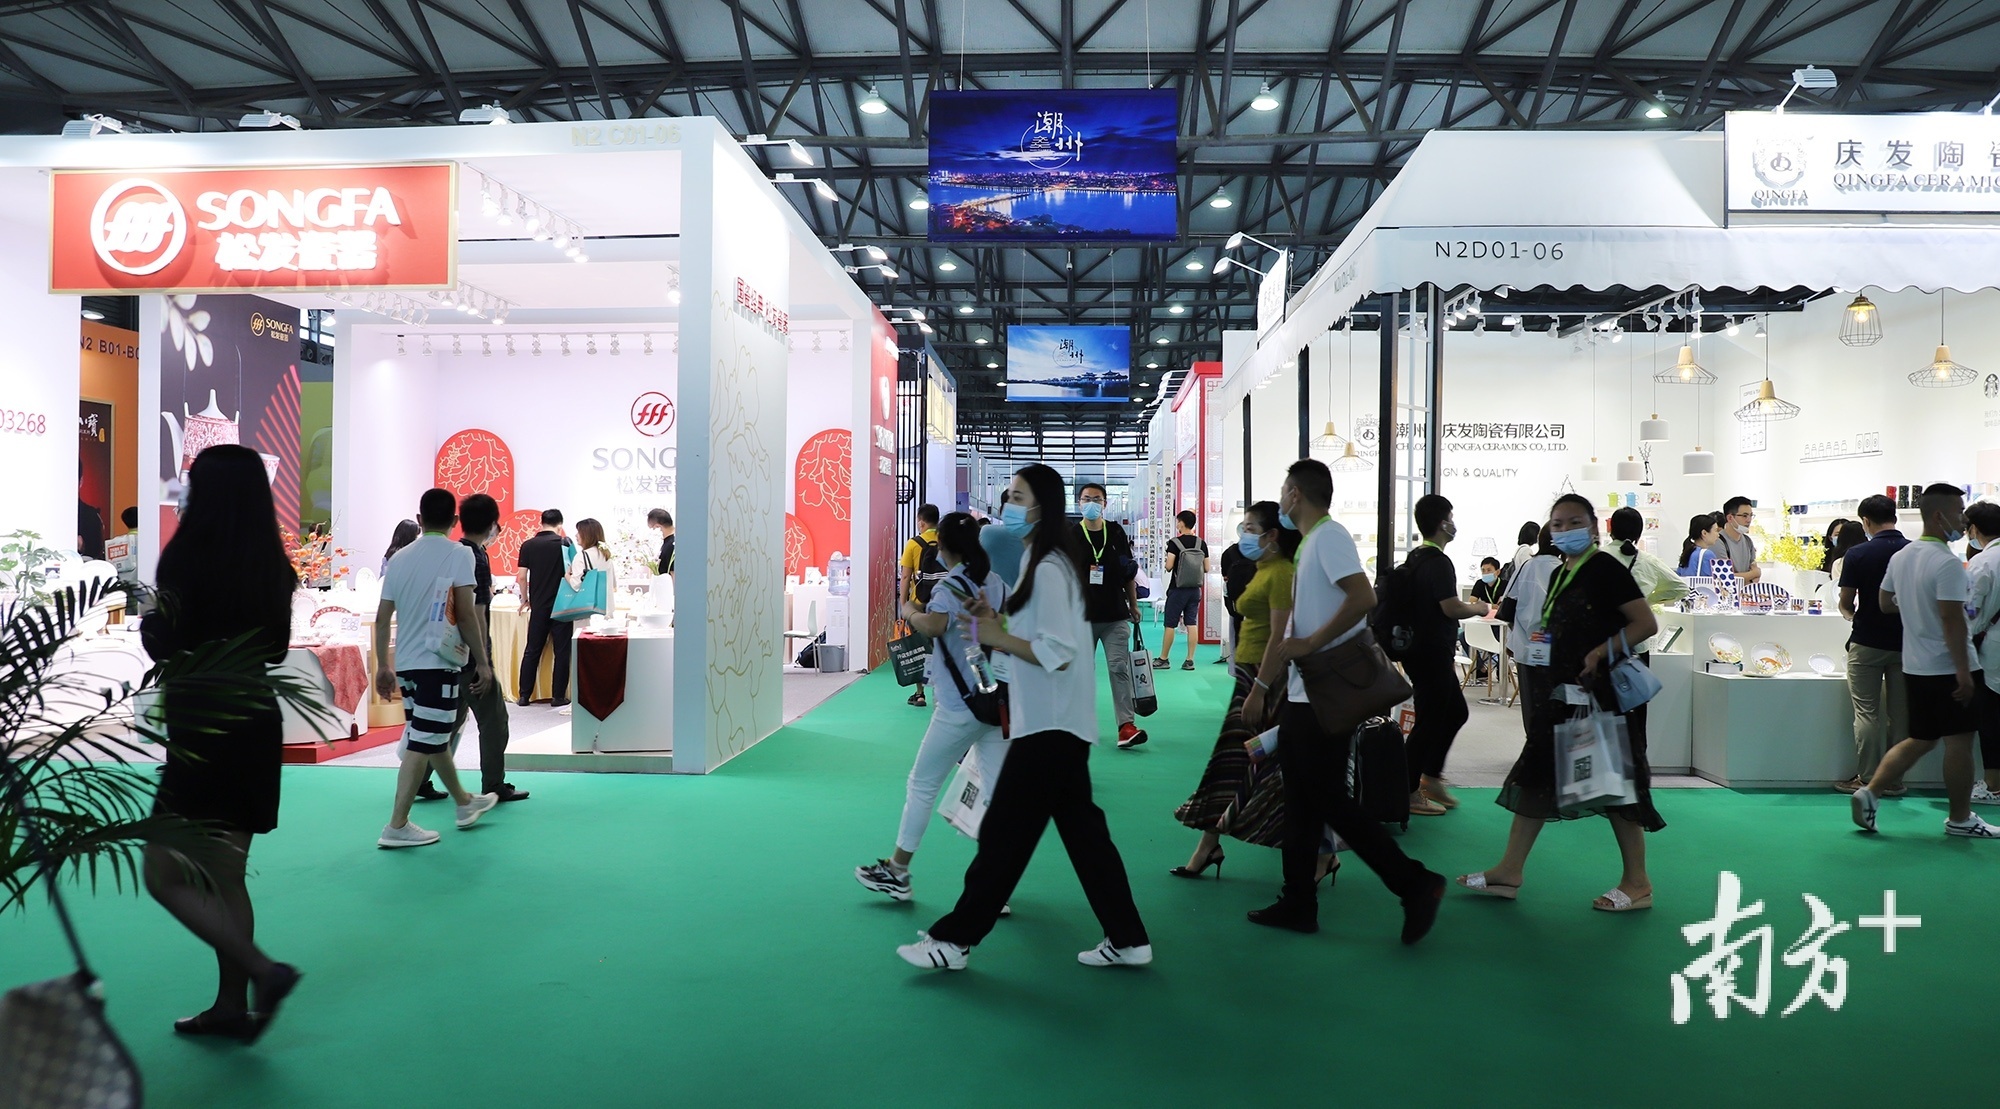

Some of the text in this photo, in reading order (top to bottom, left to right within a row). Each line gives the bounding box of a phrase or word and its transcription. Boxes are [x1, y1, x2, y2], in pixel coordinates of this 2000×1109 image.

[571, 124, 681, 146] N2 C01-06
[1034, 111, 1084, 162] 潮州
[1833, 172, 1909, 188] QINGFA
[1754, 189, 1809, 201] QINGFA
[196, 187, 401, 231] SONGFA
[1435, 240, 1564, 260] N2D01-06
[265, 318, 294, 335] SONGFA
[1396, 423, 1565, 440] 潮州庆发陶瓷有限公司
[1447, 442, 1481, 452] QINGFA
[1482, 442, 1527, 451] CERAMICS
[1462, 467, 1470, 477] &
[1473, 468, 1518, 477] QUALITY
